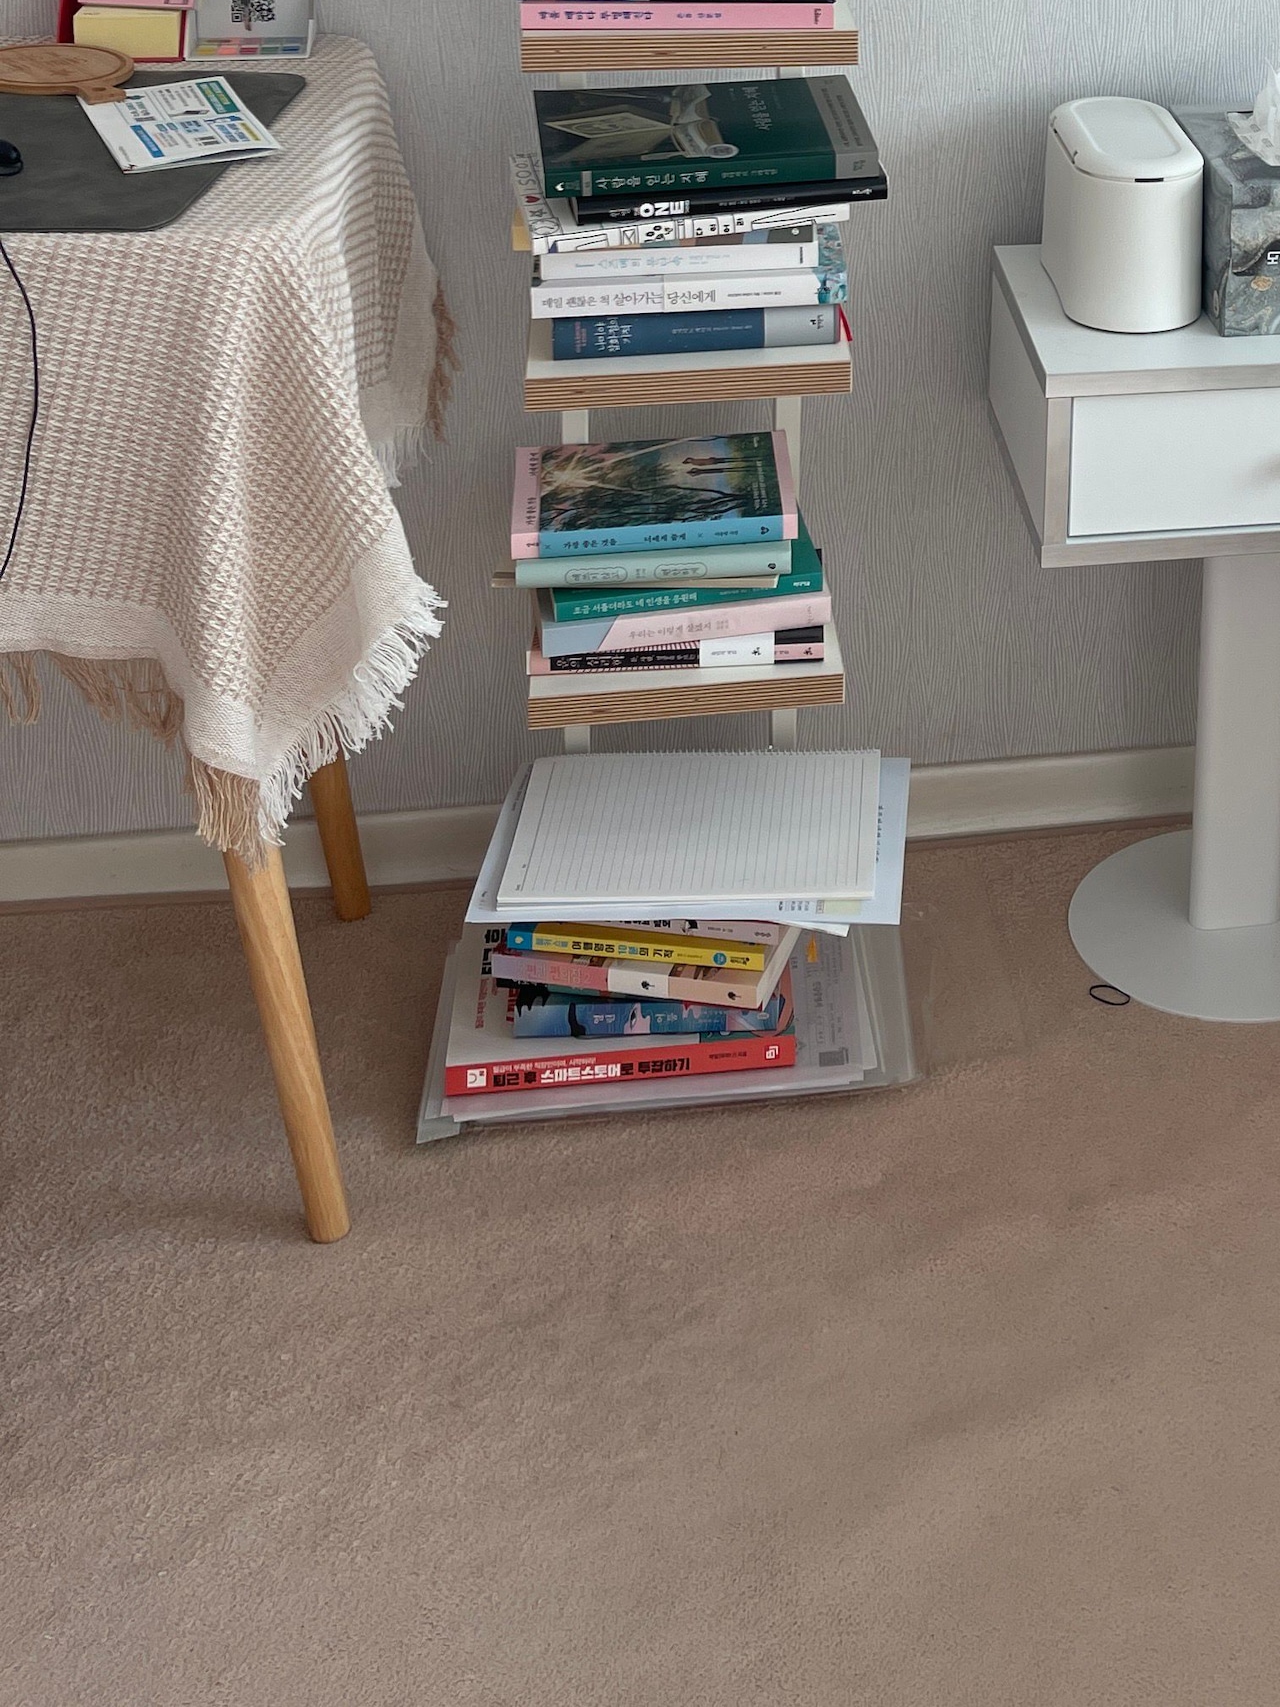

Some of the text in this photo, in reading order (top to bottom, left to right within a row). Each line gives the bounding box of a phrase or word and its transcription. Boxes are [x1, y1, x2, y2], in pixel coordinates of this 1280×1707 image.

[597, 175, 641, 190] 사람을
[645, 172, 676, 187] 얻는
[680, 170, 710, 184] 지혜
[640, 200, 685, 218] ONE
[566, 296, 598, 308] 괜찮은
[613, 292, 663, 306] 살아가는
[667, 289, 717, 305] 당신에게
[572, 604, 591, 615] 조금
[635, 599, 645, 609] 네
[646, 596, 671, 608] 인생을
[672, 593, 698, 605] 응원해
[628, 630, 656, 640] 우리는
[657, 626, 684, 637] 이렇게
[493, 1057, 690, 1087] 퇴근 후 스마트스토어로 투잡하기
